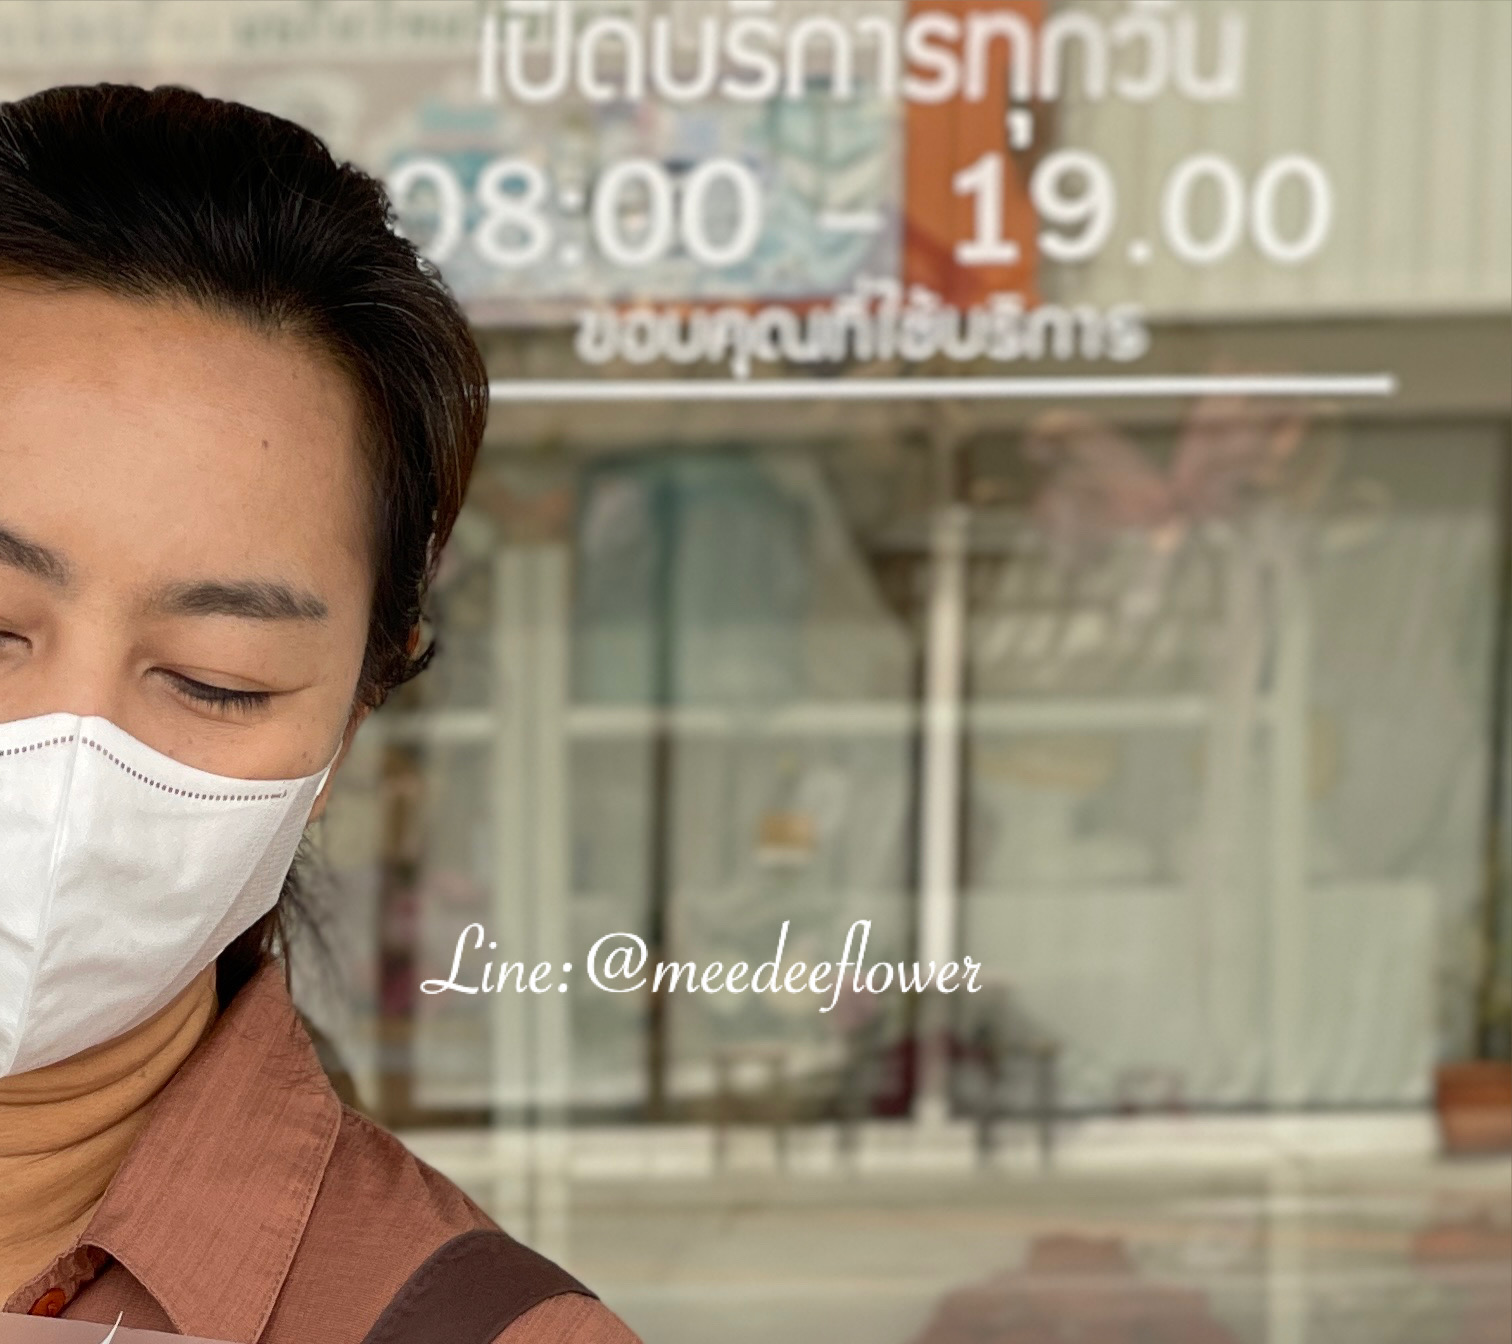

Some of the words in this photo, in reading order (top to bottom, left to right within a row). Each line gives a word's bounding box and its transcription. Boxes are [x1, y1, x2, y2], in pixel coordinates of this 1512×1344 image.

[480, 0, 1244, 150] เปดบรการทุกวน
[380, 158, 762, 266] 08:00
[951, 150, 1332, 266] 19.00
